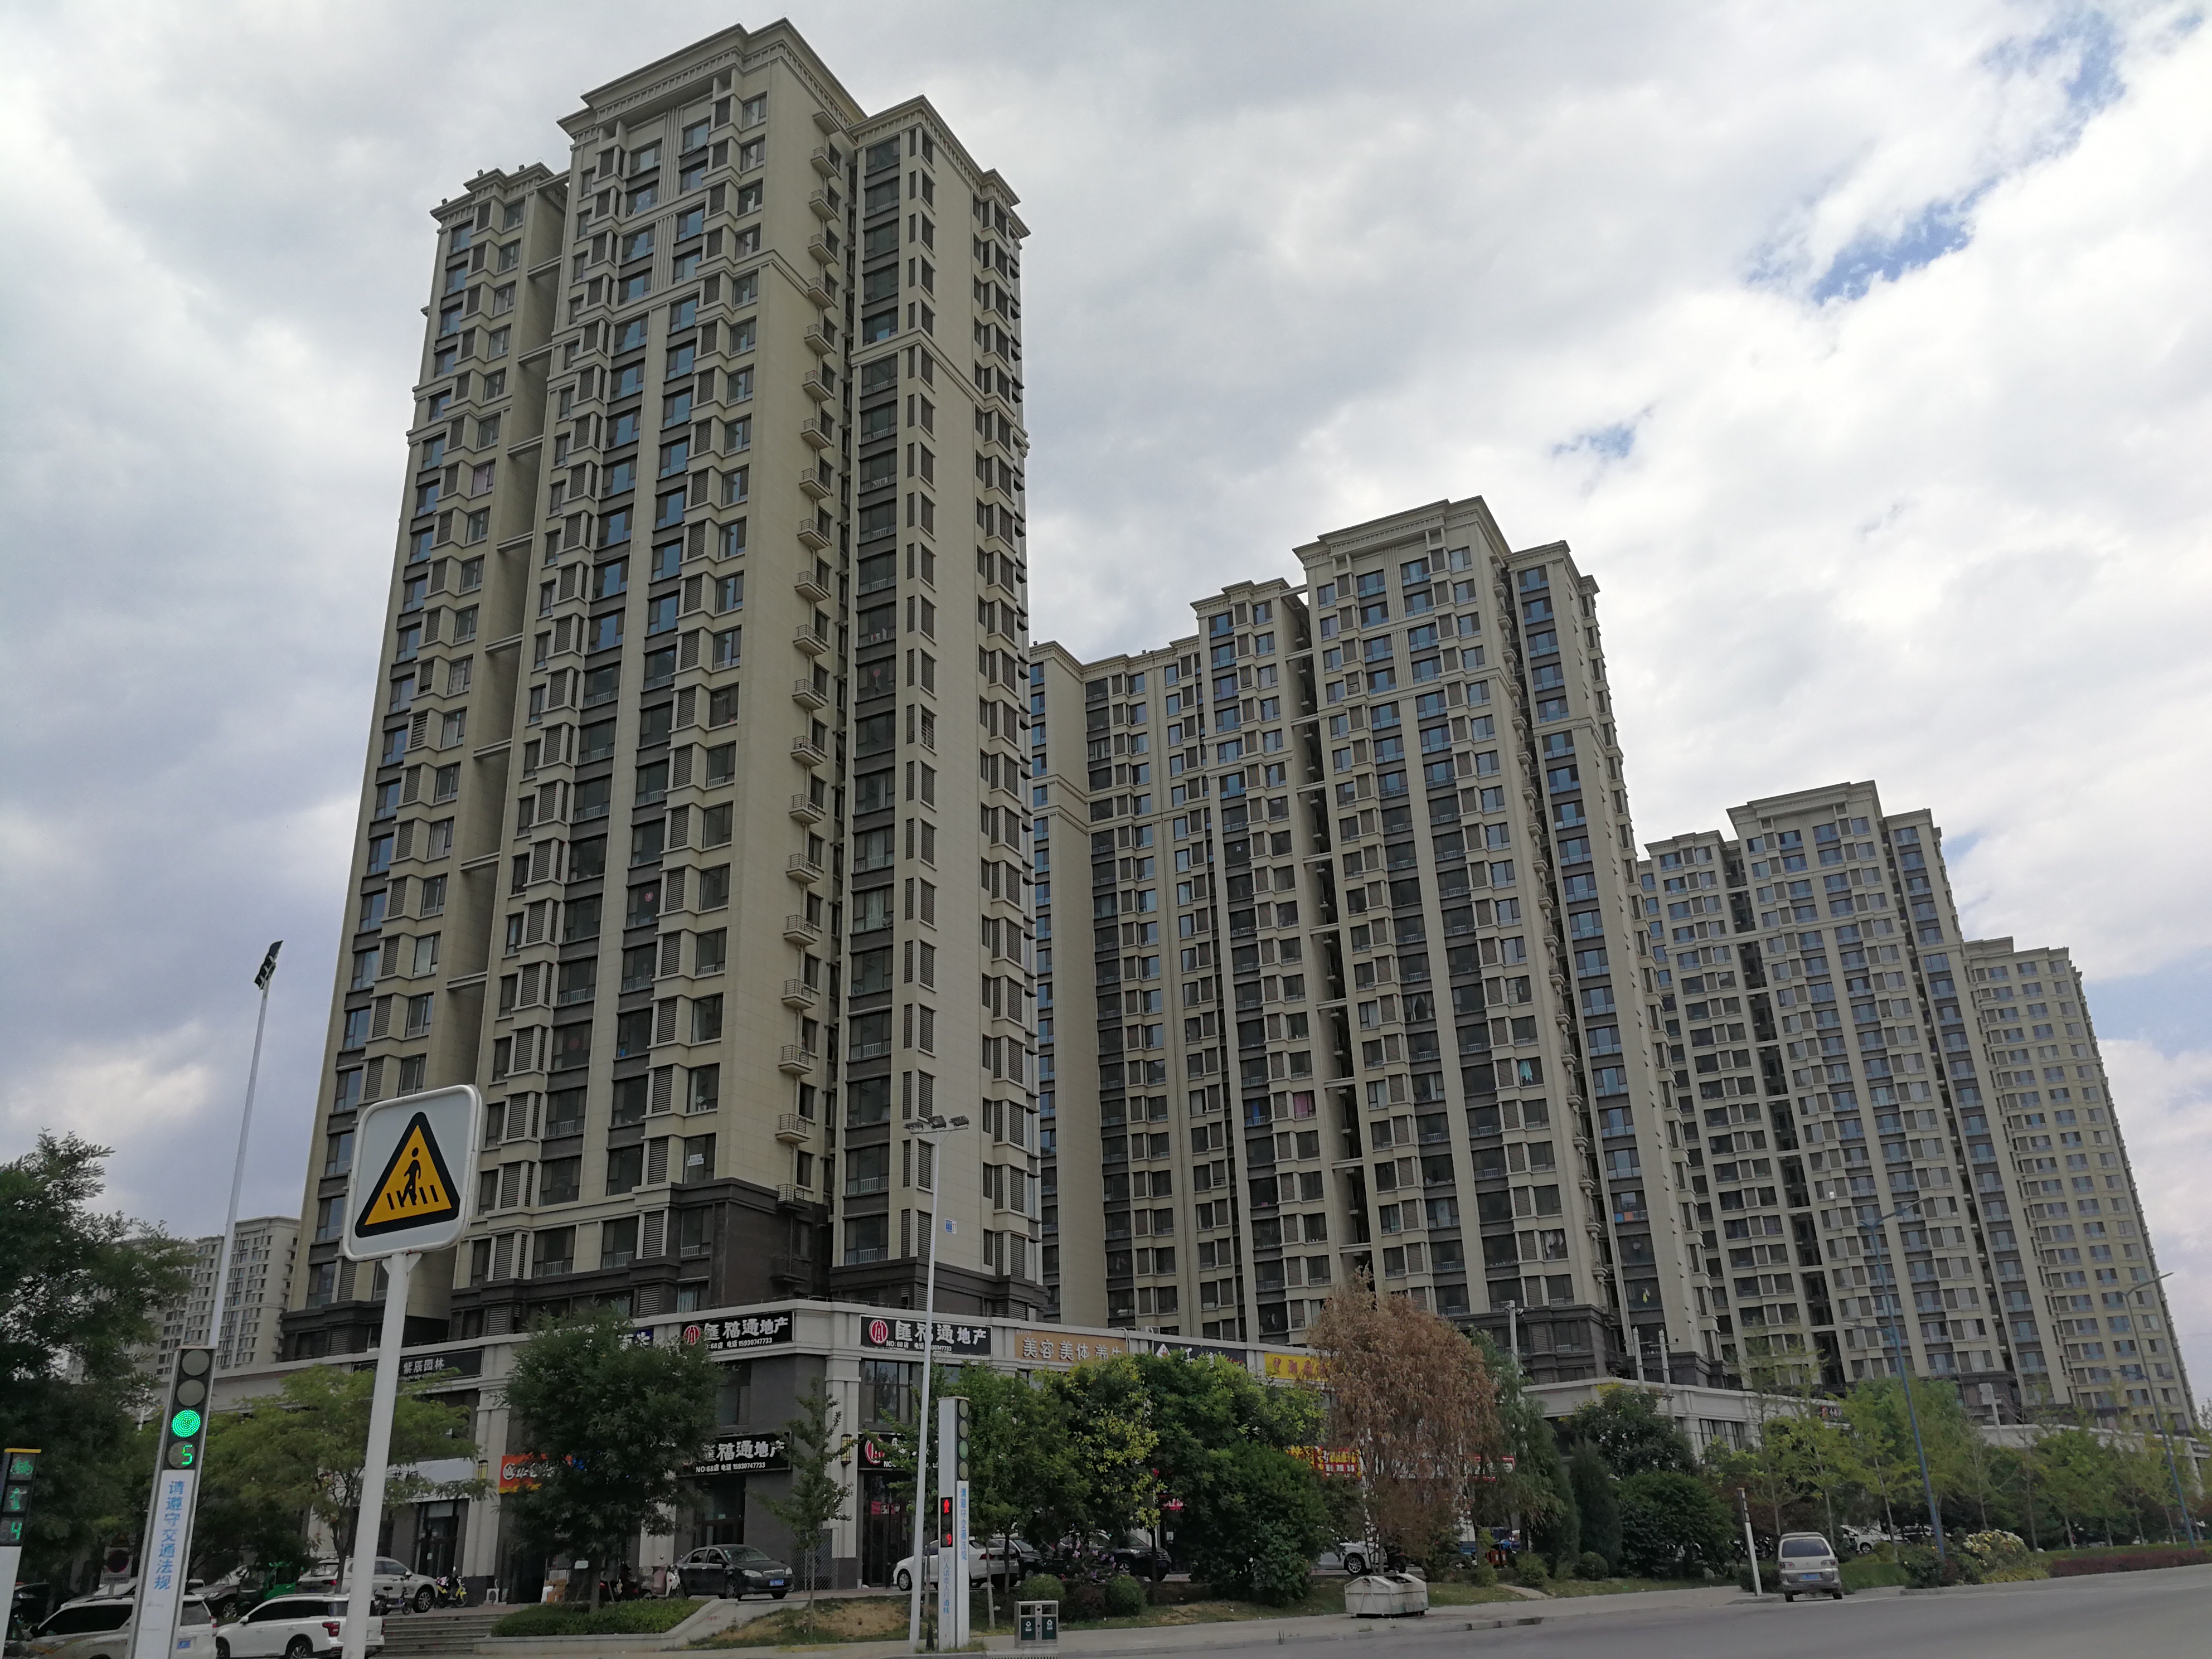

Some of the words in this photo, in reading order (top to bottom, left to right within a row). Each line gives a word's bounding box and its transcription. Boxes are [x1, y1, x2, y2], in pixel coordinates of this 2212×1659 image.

[726, 1340, 738, 1348] 电话
[739, 1337, 773, 1346] 15930747733
[403, 1357, 445, 1375] 紫辰园林
[181, 1444, 193, 1465] 5
[11, 1521, 22, 1540] 4
[154, 1481, 185, 1590] 请遵守交通法规
